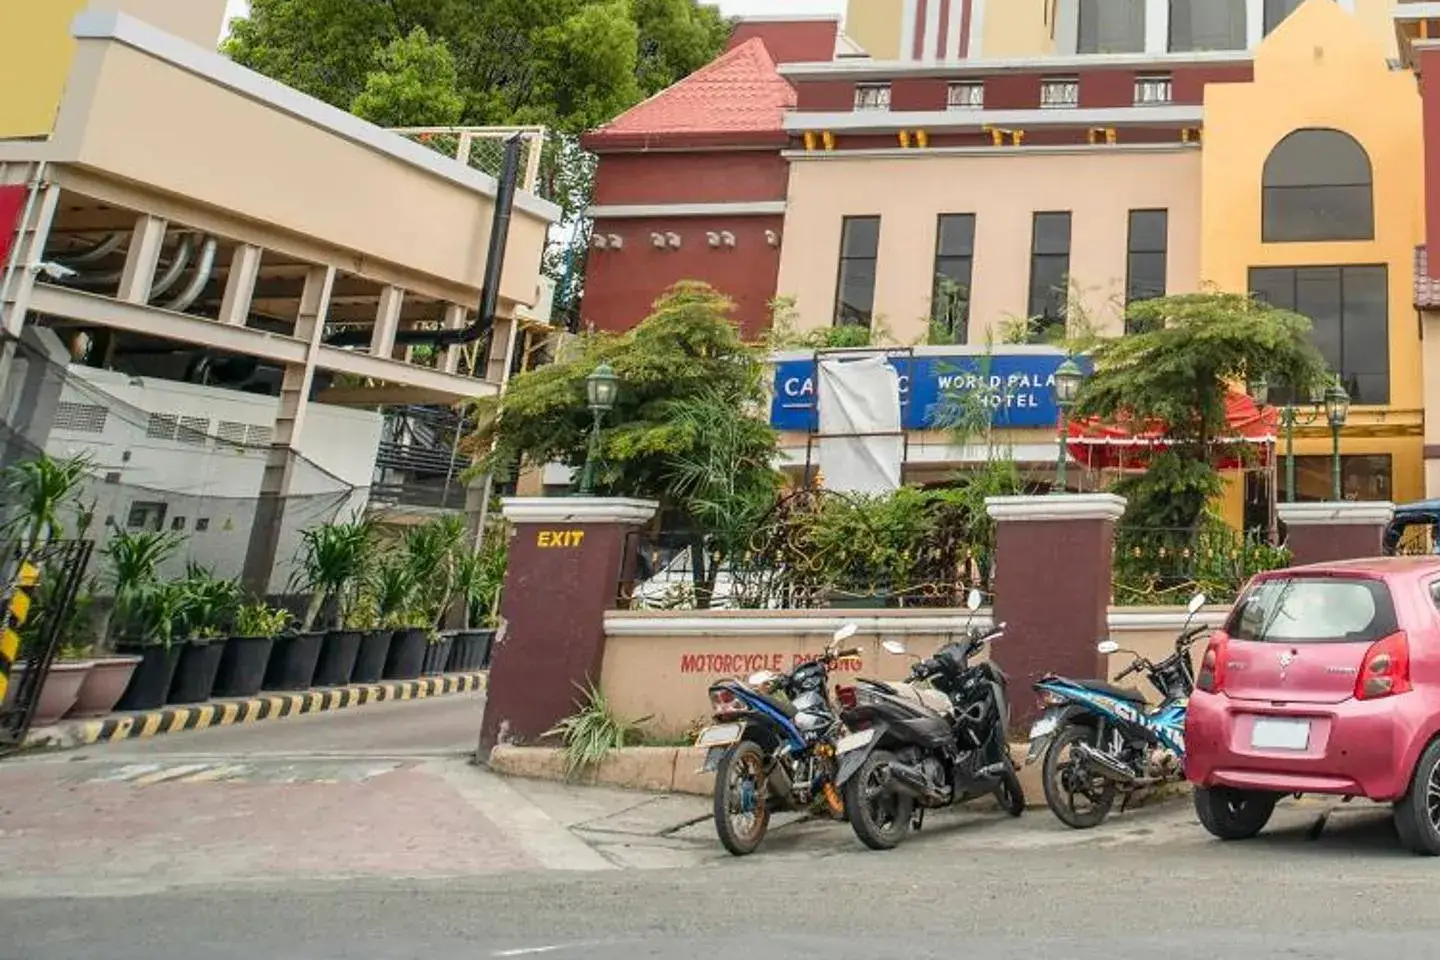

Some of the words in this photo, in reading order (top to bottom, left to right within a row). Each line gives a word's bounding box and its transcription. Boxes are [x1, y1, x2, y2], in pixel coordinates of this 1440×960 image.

[1008, 374, 1056, 388] PALA
[536, 530, 585, 548] EXIT
[681, 653, 783, 673] MOTORCYCLE
